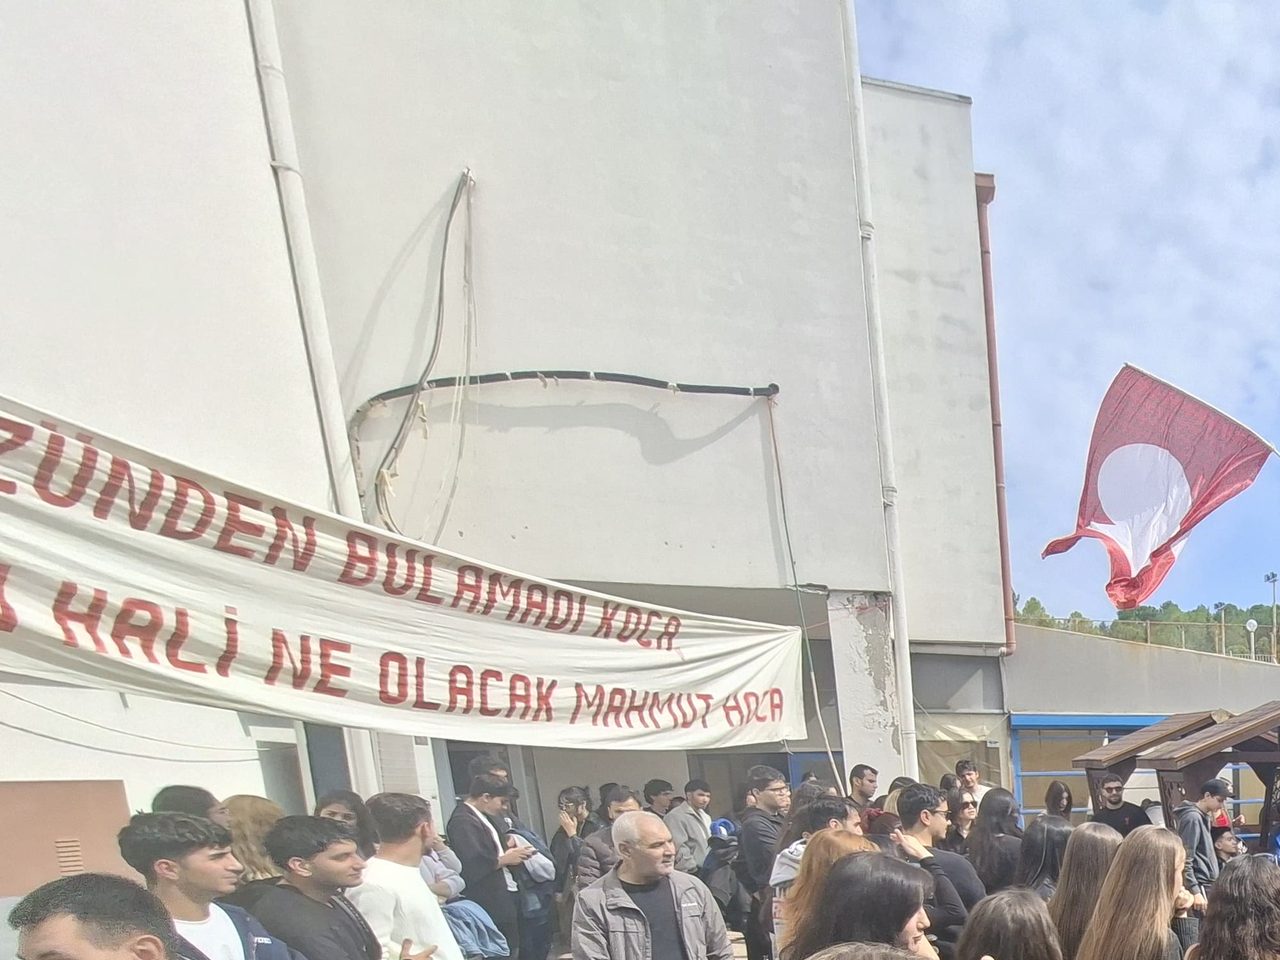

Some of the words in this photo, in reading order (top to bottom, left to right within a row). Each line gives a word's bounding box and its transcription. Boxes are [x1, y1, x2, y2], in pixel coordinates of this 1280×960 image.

[336, 530, 588, 633] BULAMADI
[53, 580, 239, 678] HALİ
[264, 626, 352, 698] NE
[378, 650, 558, 723] OLACAK
[568, 682, 715, 729] MAHMUT
[722, 687, 784, 727] HOCA
